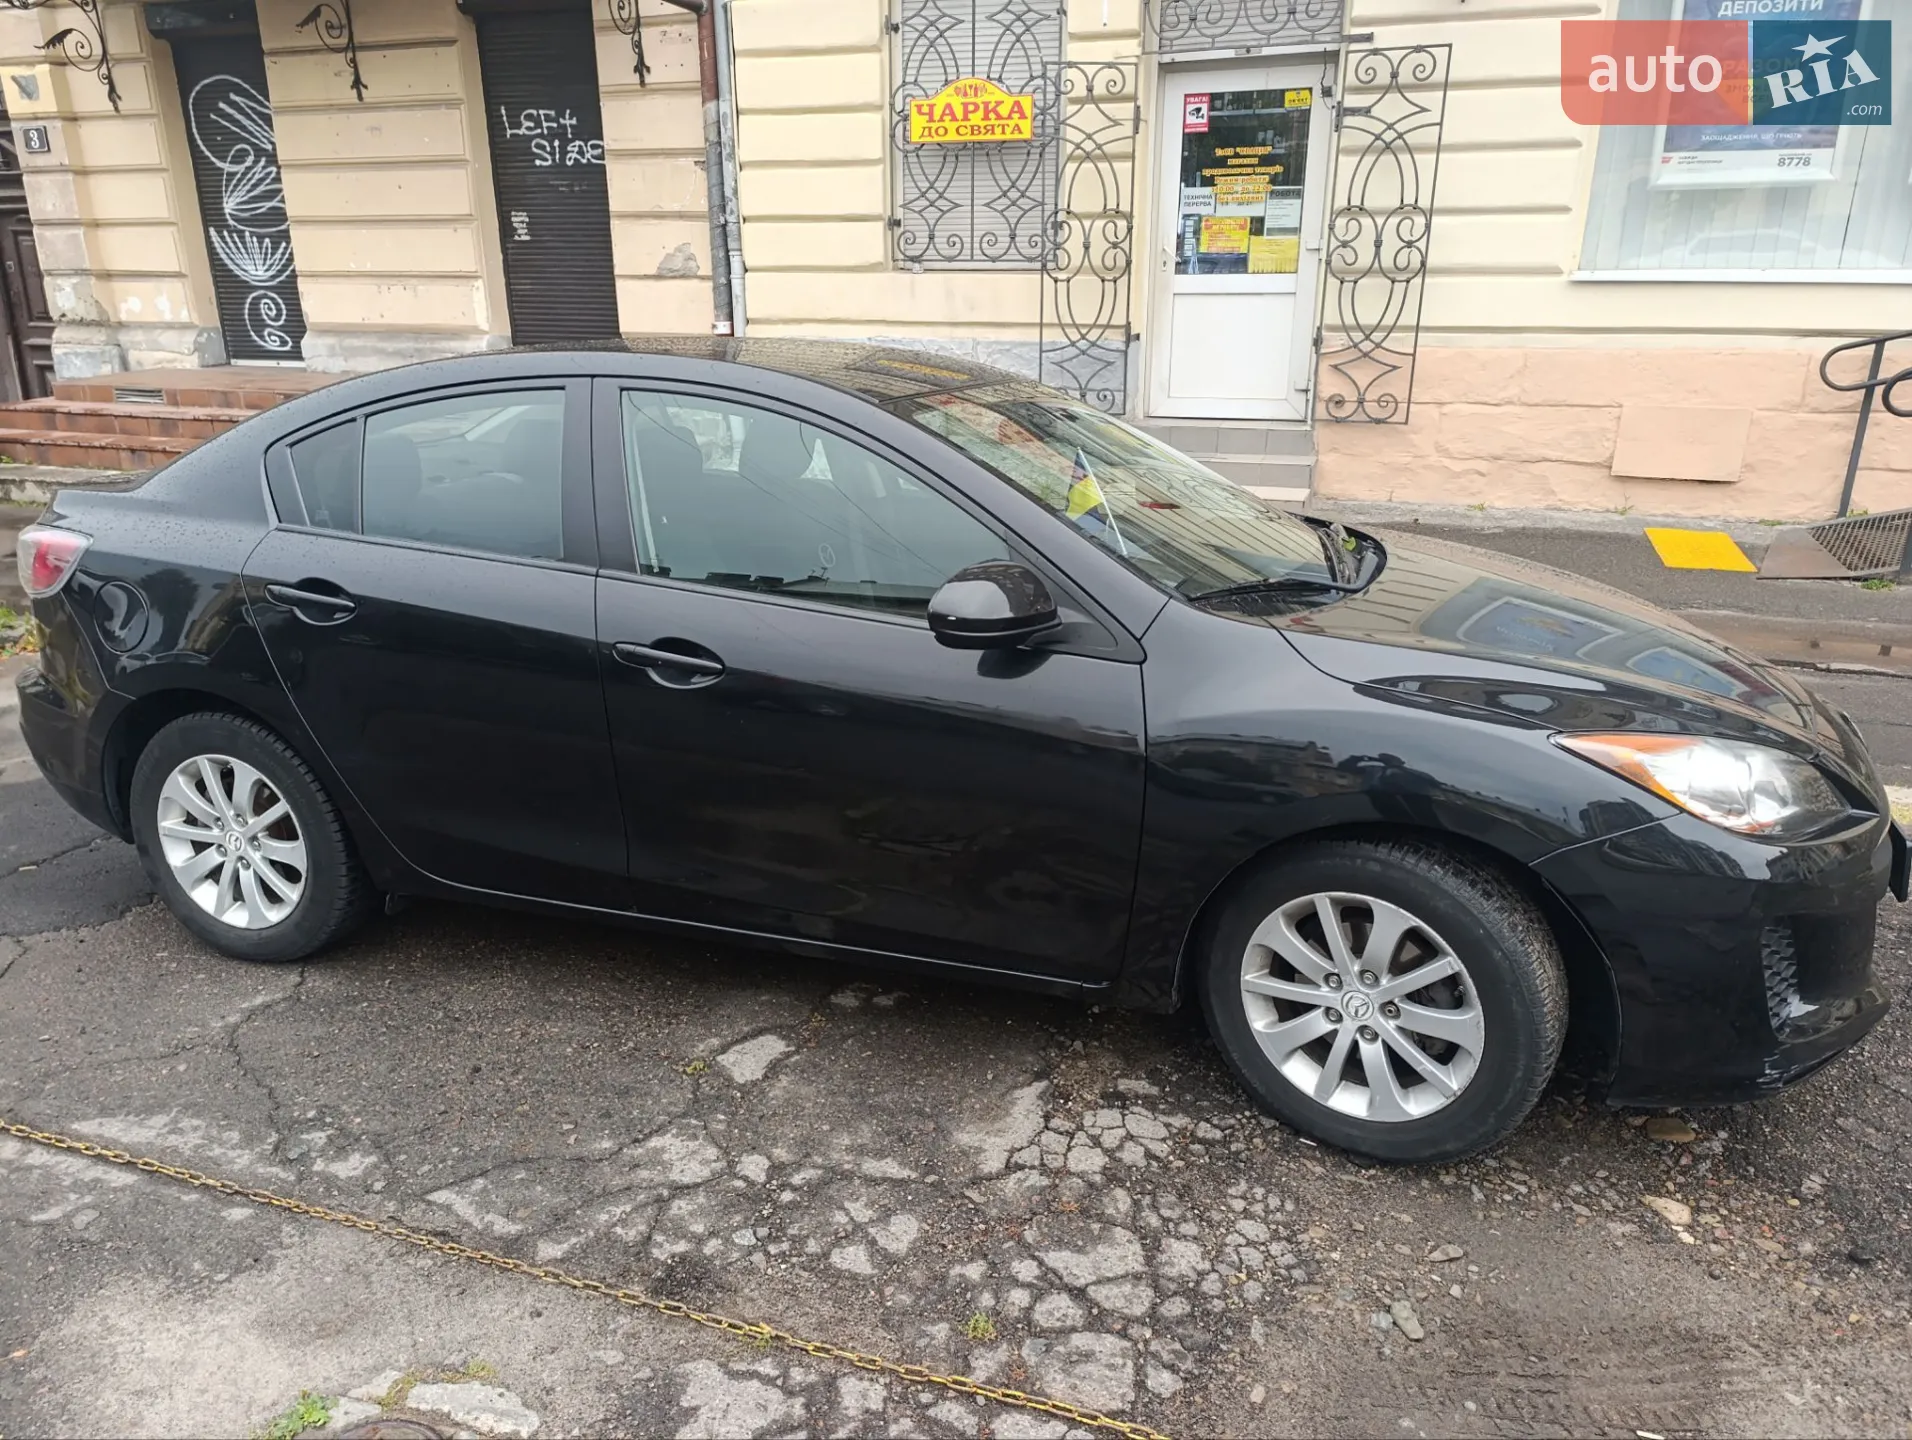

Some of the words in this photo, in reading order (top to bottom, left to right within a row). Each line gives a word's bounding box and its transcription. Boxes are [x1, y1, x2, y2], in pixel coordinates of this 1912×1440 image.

[1717, 0, 1824, 18] ДЕПОЗИТИ
[914, 100, 1028, 123] ЧАРКА
[29, 129, 40, 149] 3
[918, 125, 949, 139] ДО
[955, 123, 1024, 137] СВЯТА
[531, 138, 606, 166] SIDE
[1777, 156, 1812, 167] 8778
